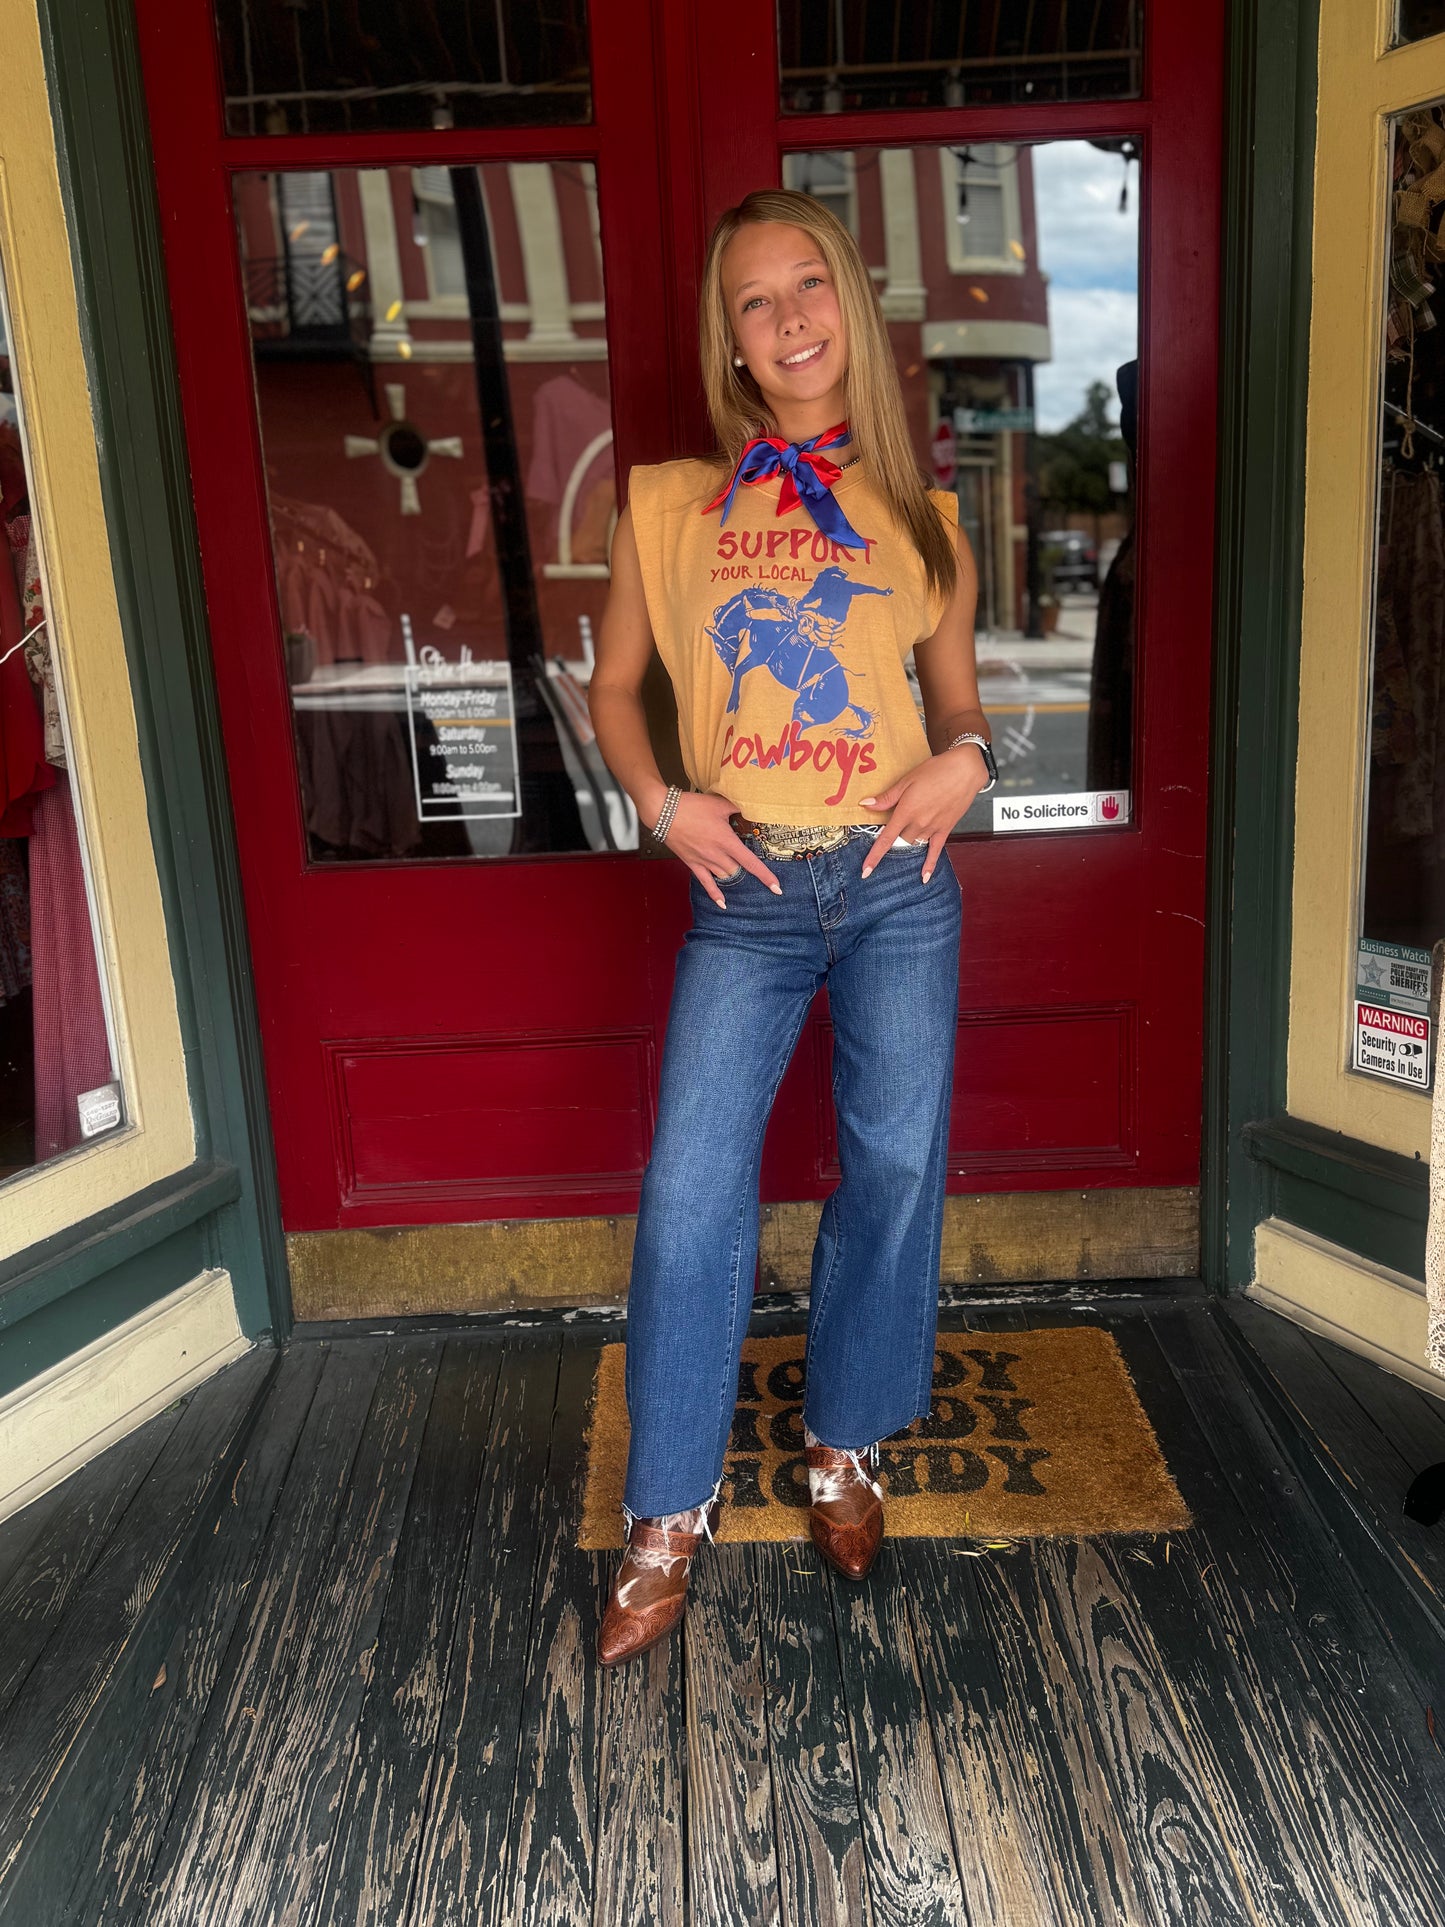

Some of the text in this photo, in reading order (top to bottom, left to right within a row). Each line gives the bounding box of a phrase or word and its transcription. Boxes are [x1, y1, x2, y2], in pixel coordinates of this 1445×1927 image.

[710, 564, 814, 583] YOUR LOCAL
[420, 690, 498, 708] Monday-Friday
[438, 726, 487, 742] Saturday
[459, 744, 467, 754] to
[445, 763, 485, 780] Sunday
[721, 720, 878, 807] Cowboys
[1001, 804, 1088, 820] No Solicitors
[1360, 939, 1431, 964] Business Watch
[1390, 967, 1428, 981] POLK COUNTY
[1390, 975, 1428, 993] SHERIFF'S
[1361, 1007, 1425, 1037] WARNING
[1361, 1030, 1397, 1056] Security
[1361, 1049, 1423, 1079] Cameras In Use
